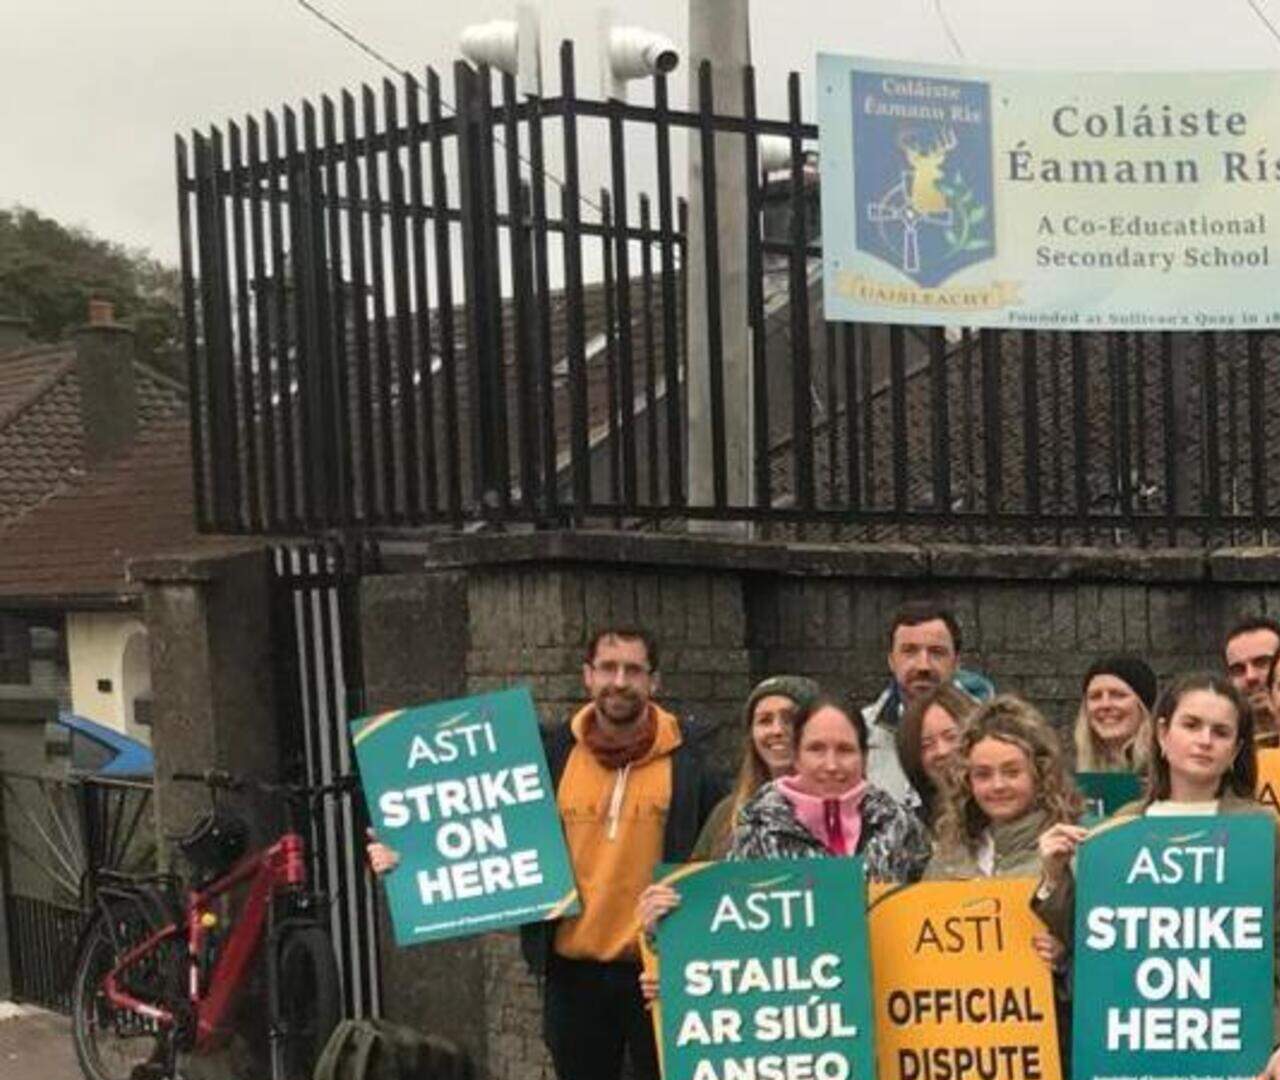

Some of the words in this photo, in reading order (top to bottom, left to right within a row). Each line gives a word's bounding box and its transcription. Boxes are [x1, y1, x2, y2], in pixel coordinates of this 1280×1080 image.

[1053, 104, 1247, 138] Coláiste
[1006, 141, 1199, 184] Éamann
[1037, 216, 1054, 235] A
[1063, 214, 1266, 236] Co-Educational
[1036, 247, 1174, 272] Secondary
[1184, 246, 1269, 268] School
[1009, 311, 1079, 324] Founded
[407, 722, 496, 769] ASTI
[378, 763, 544, 828] STRIKE
[435, 814, 508, 860] ON
[416, 849, 543, 906] HERE
[1127, 847, 1225, 885] ASTI
[710, 889, 815, 933] ASTI
[1086, 906, 1264, 951] STRIKE
[915, 914, 1003, 954] ASTI
[684, 953, 842, 997] STAILC
[1136, 957, 1211, 1001] ON
[676, 1009, 742, 1047] AR
[755, 1000, 857, 1041] SIÚL
[888, 986, 1044, 1027] OFFICIAL
[1106, 1008, 1242, 1052] HERE
